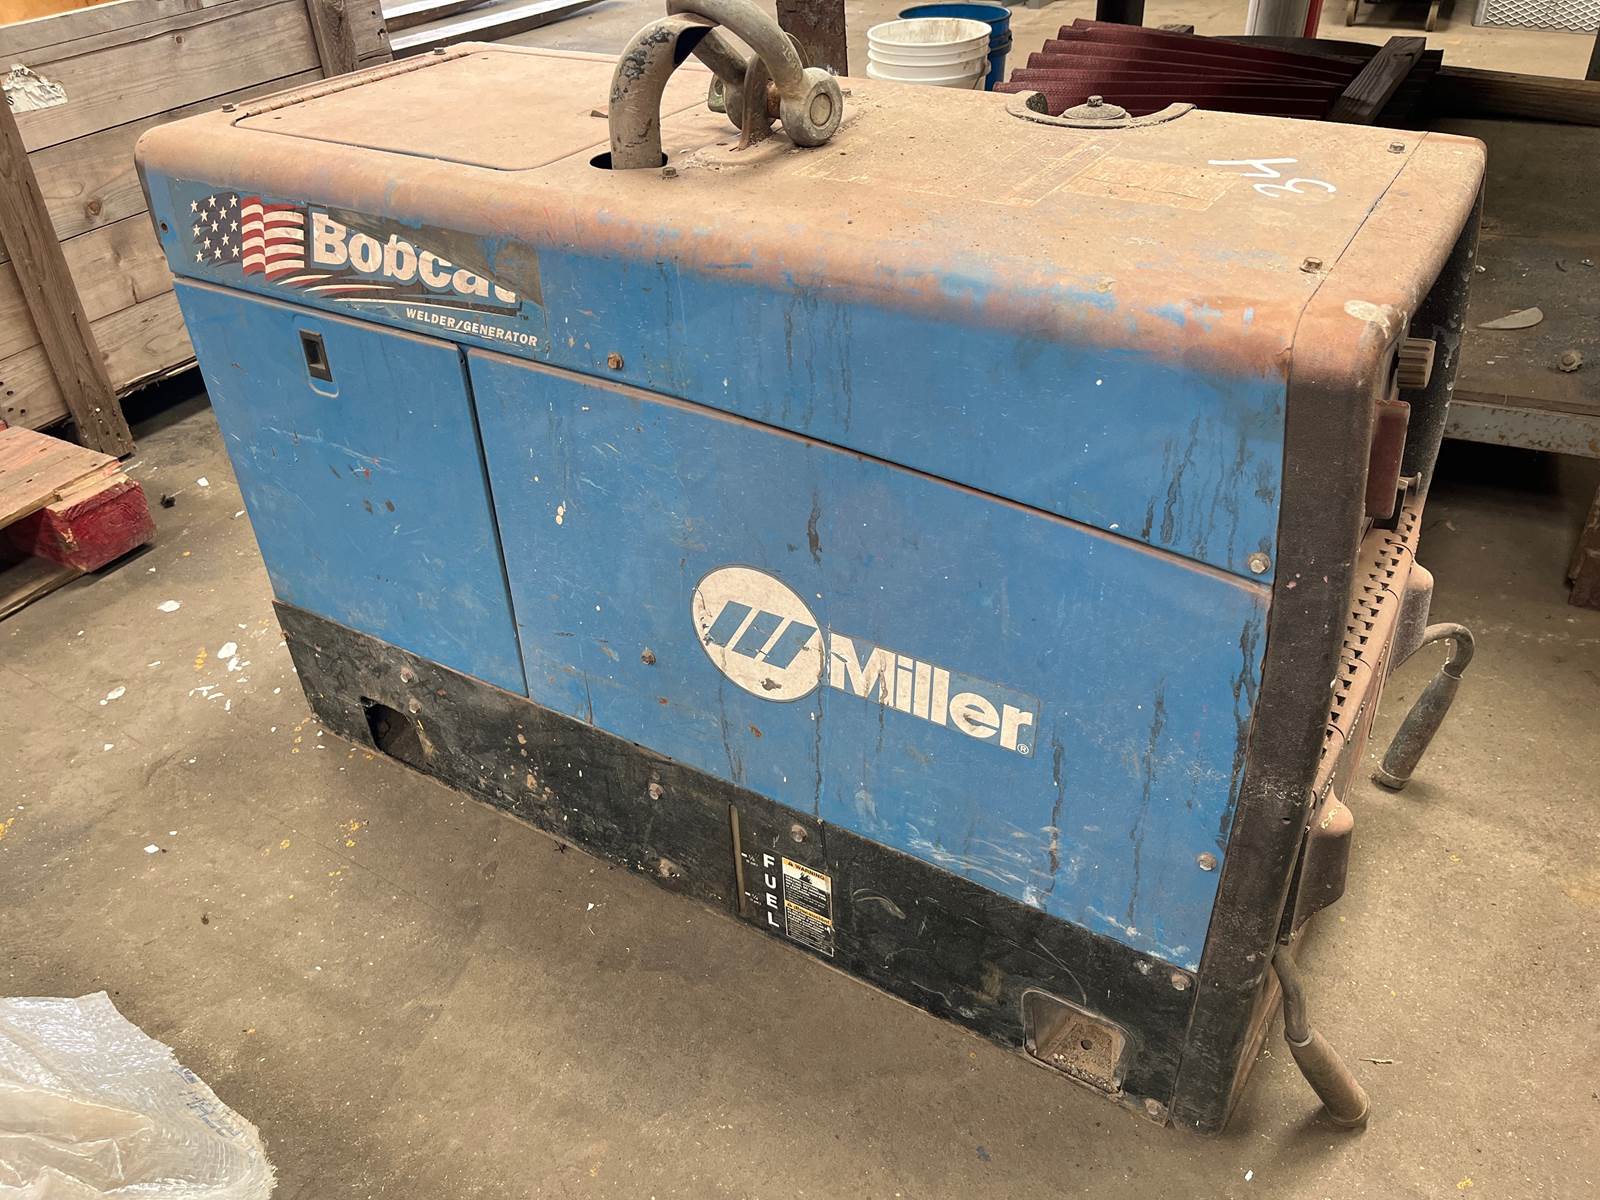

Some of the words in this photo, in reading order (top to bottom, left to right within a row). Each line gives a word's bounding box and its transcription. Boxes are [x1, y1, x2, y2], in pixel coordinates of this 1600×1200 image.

[406, 308, 538, 346] WELDER/GENERATOR
[829, 632, 1034, 751] Miller
[763, 853, 780, 928] FUEL
